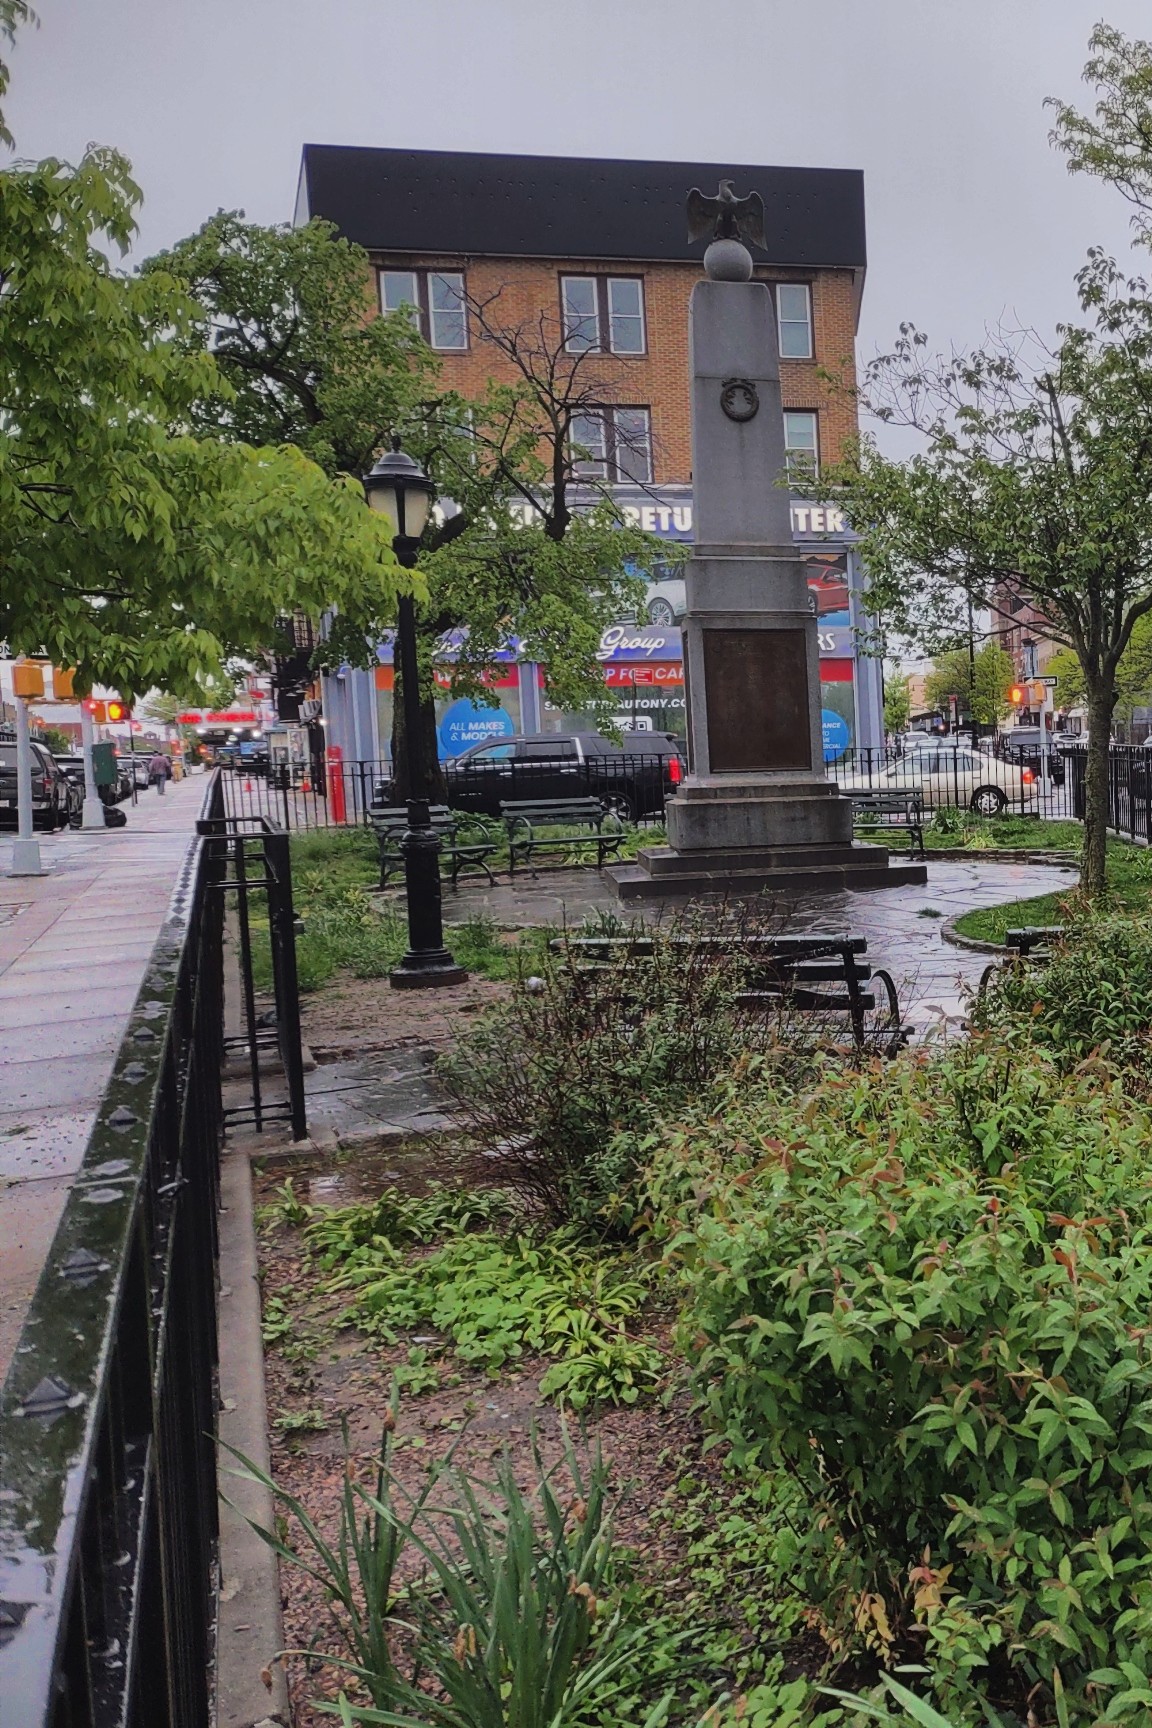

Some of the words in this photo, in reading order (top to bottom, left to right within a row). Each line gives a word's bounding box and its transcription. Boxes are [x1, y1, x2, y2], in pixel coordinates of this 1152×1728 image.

[623, 506, 692, 532] RETU
[790, 508, 845, 532] TER
[595, 626, 666, 660] Group
[449, 722, 466, 731] ALL
[468, 721, 505, 731] MAKES
[451, 732, 458, 741] &
